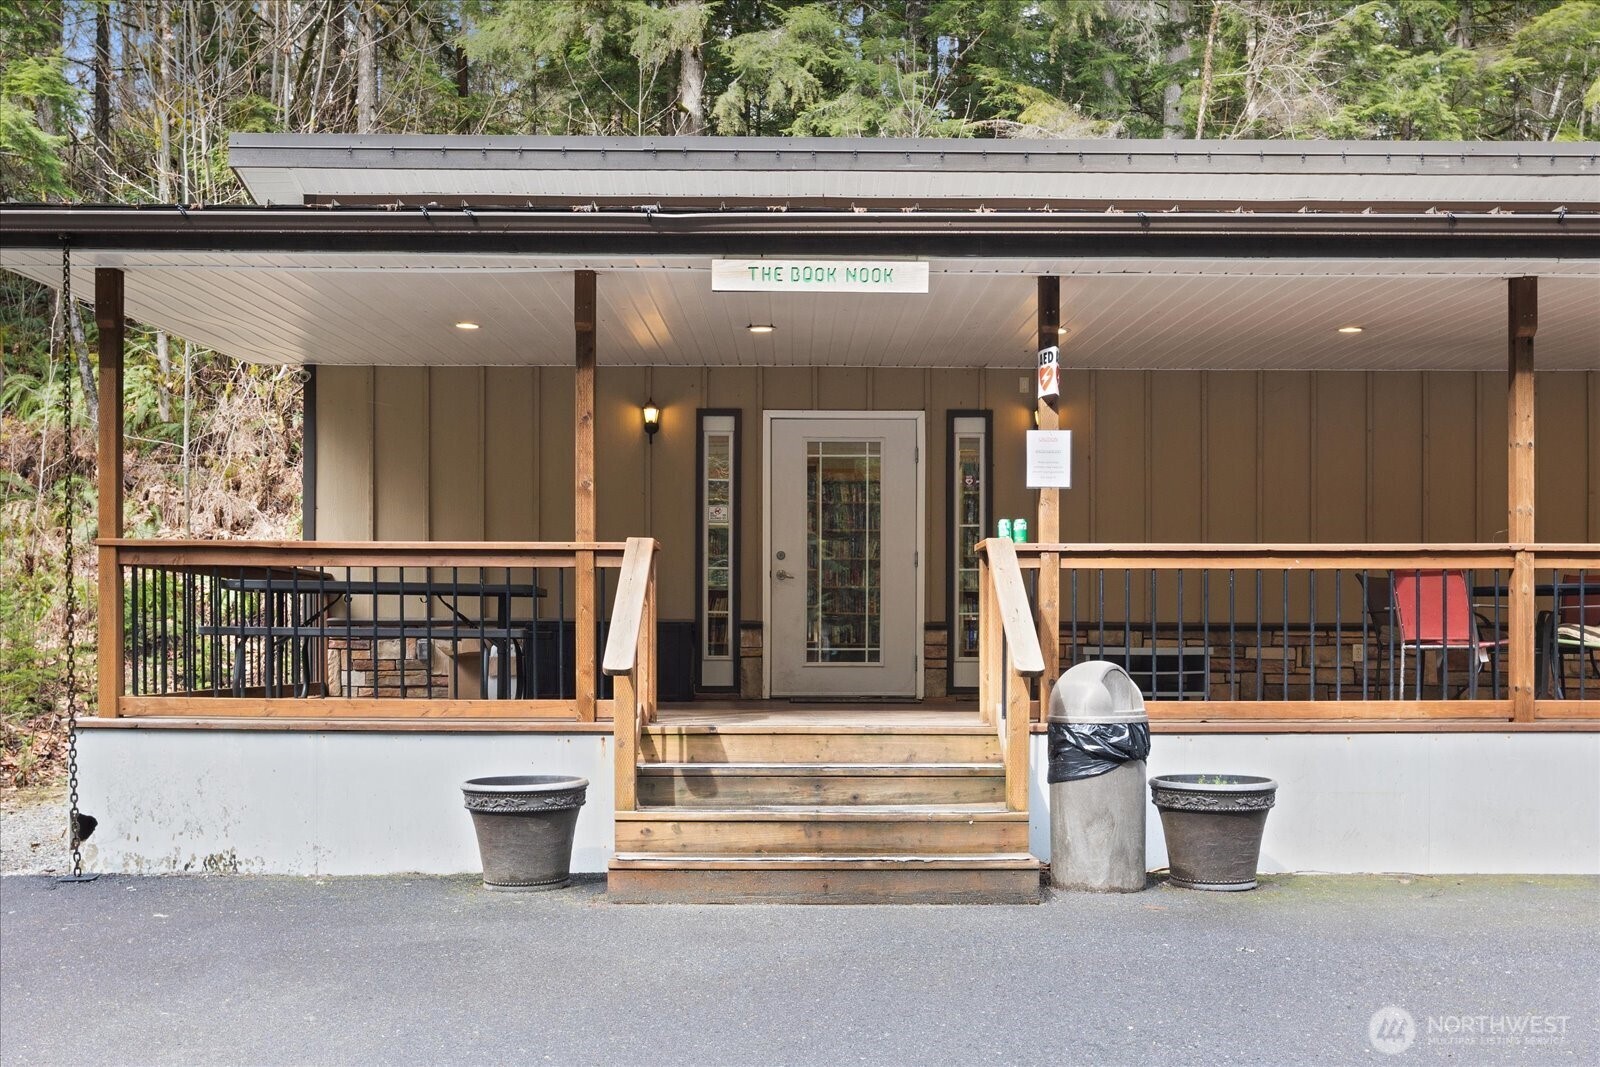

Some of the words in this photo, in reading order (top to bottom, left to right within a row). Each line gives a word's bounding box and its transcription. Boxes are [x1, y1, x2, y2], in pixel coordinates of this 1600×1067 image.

[747, 266, 784, 282] THE
[790, 266, 837, 283] BOOK
[845, 267, 894, 283] NOOK
